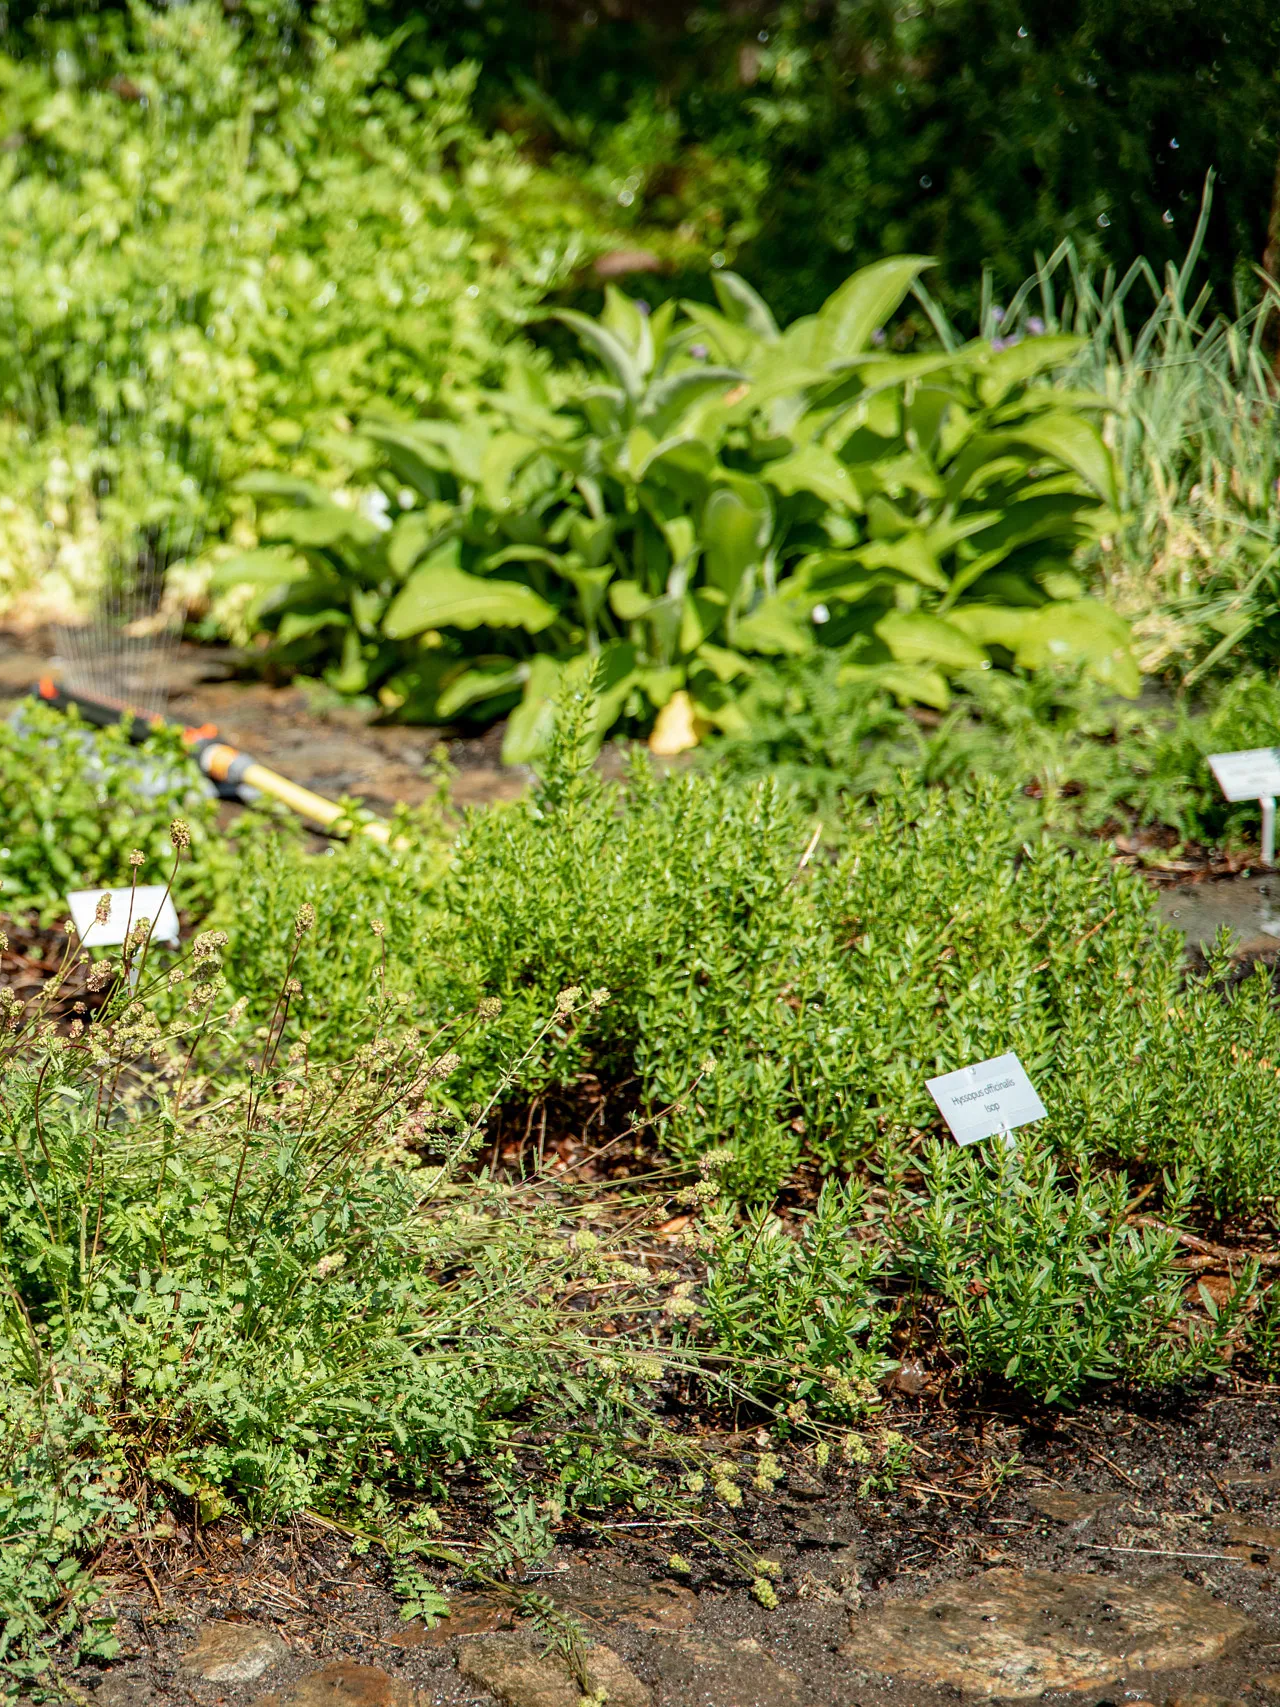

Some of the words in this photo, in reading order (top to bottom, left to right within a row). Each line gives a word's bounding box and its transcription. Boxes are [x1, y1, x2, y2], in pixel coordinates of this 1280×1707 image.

[951, 1089, 984, 1106] Hyssopus
[984, 1078, 1016, 1095] officinalis
[984, 1102, 1000, 1113] Isop
